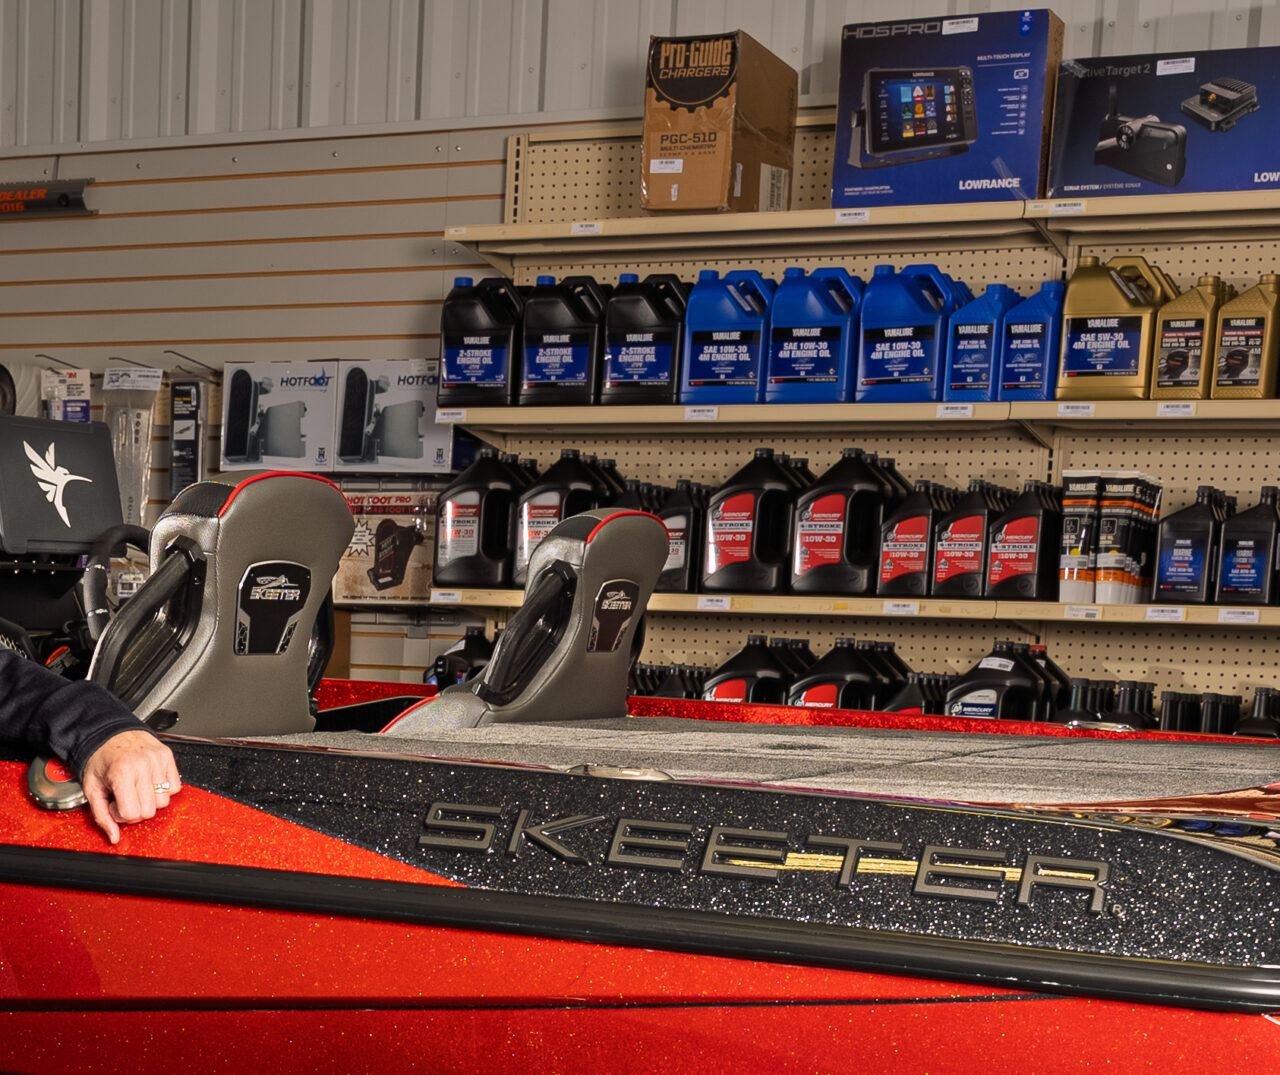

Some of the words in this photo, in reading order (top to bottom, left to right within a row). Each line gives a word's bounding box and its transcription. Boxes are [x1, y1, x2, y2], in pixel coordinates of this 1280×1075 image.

[977, 53, 1010, 61] MULTI-TOUCH
[659, 66, 730, 80] CHARGERS
[1073, 64, 1140, 78] tiveTarget
[1143, 64, 1151, 74] 2
[660, 131, 717, 145] PGC-510
[959, 178, 1020, 190] LOWRANCE
[1087, 318, 1120, 328] YAMALUBE
[792, 328, 822, 337] YAMALUBE
[884, 327, 915, 338] YAMALUBE
[958, 325, 990, 334] YAMALUBE
[1011, 324, 1043, 334] YAMALUBE
[463, 336, 491, 345] YAMALUBE
[542, 334, 571, 343] YAMALUBE
[625, 333, 654, 342] YAMALUBE
[712, 331, 741, 341] YAMALUBE
[1081, 333, 1097, 342] SAE
[1097, 332, 1124, 341] 5W-30
[703, 346, 717, 354] SAE
[719, 345, 748, 353] 10W-30
[783, 342, 797, 350] SAE
[799, 341, 828, 350] 10W-30
[875, 343, 890, 351] SAE
[892, 341, 921, 350] 10W-30
[1072, 341, 1085, 350] 4M
[1087, 340, 1115, 349] ENGINE
[1117, 340, 1131, 349] OIL
[459, 349, 492, 357] 2-STROKE
[538, 347, 573, 356] 2-STROKE
[621, 346, 656, 355] 2-STROKE
[778, 350, 790, 358] 4M
[791, 350, 817, 358] ENGINE
[819, 349, 831, 358] OIL
[870, 351, 882, 360] 4M
[884, 350, 911, 359] ENGINE
[912, 349, 925, 357] OIL
[456, 357, 481, 365] ENGINE
[482, 356, 493, 365] OIL
[535, 355, 561, 364] ENGINE
[562, 354, 574, 363] OIL
[618, 354, 644, 363] ENGINE
[645, 354, 657, 362] OIL
[698, 354, 710, 362] 4M
[711, 353, 737, 362] ENGINE
[738, 353, 751, 361] OIL
[280, 376, 332, 388] HOTFOOT
[368, 496, 393, 505] FOOT
[395, 496, 411, 504] PRO
[249, 586, 301, 601] SKEETER
[601, 600, 632, 610] SKEETER
[420, 801, 1112, 914] SKEETER
